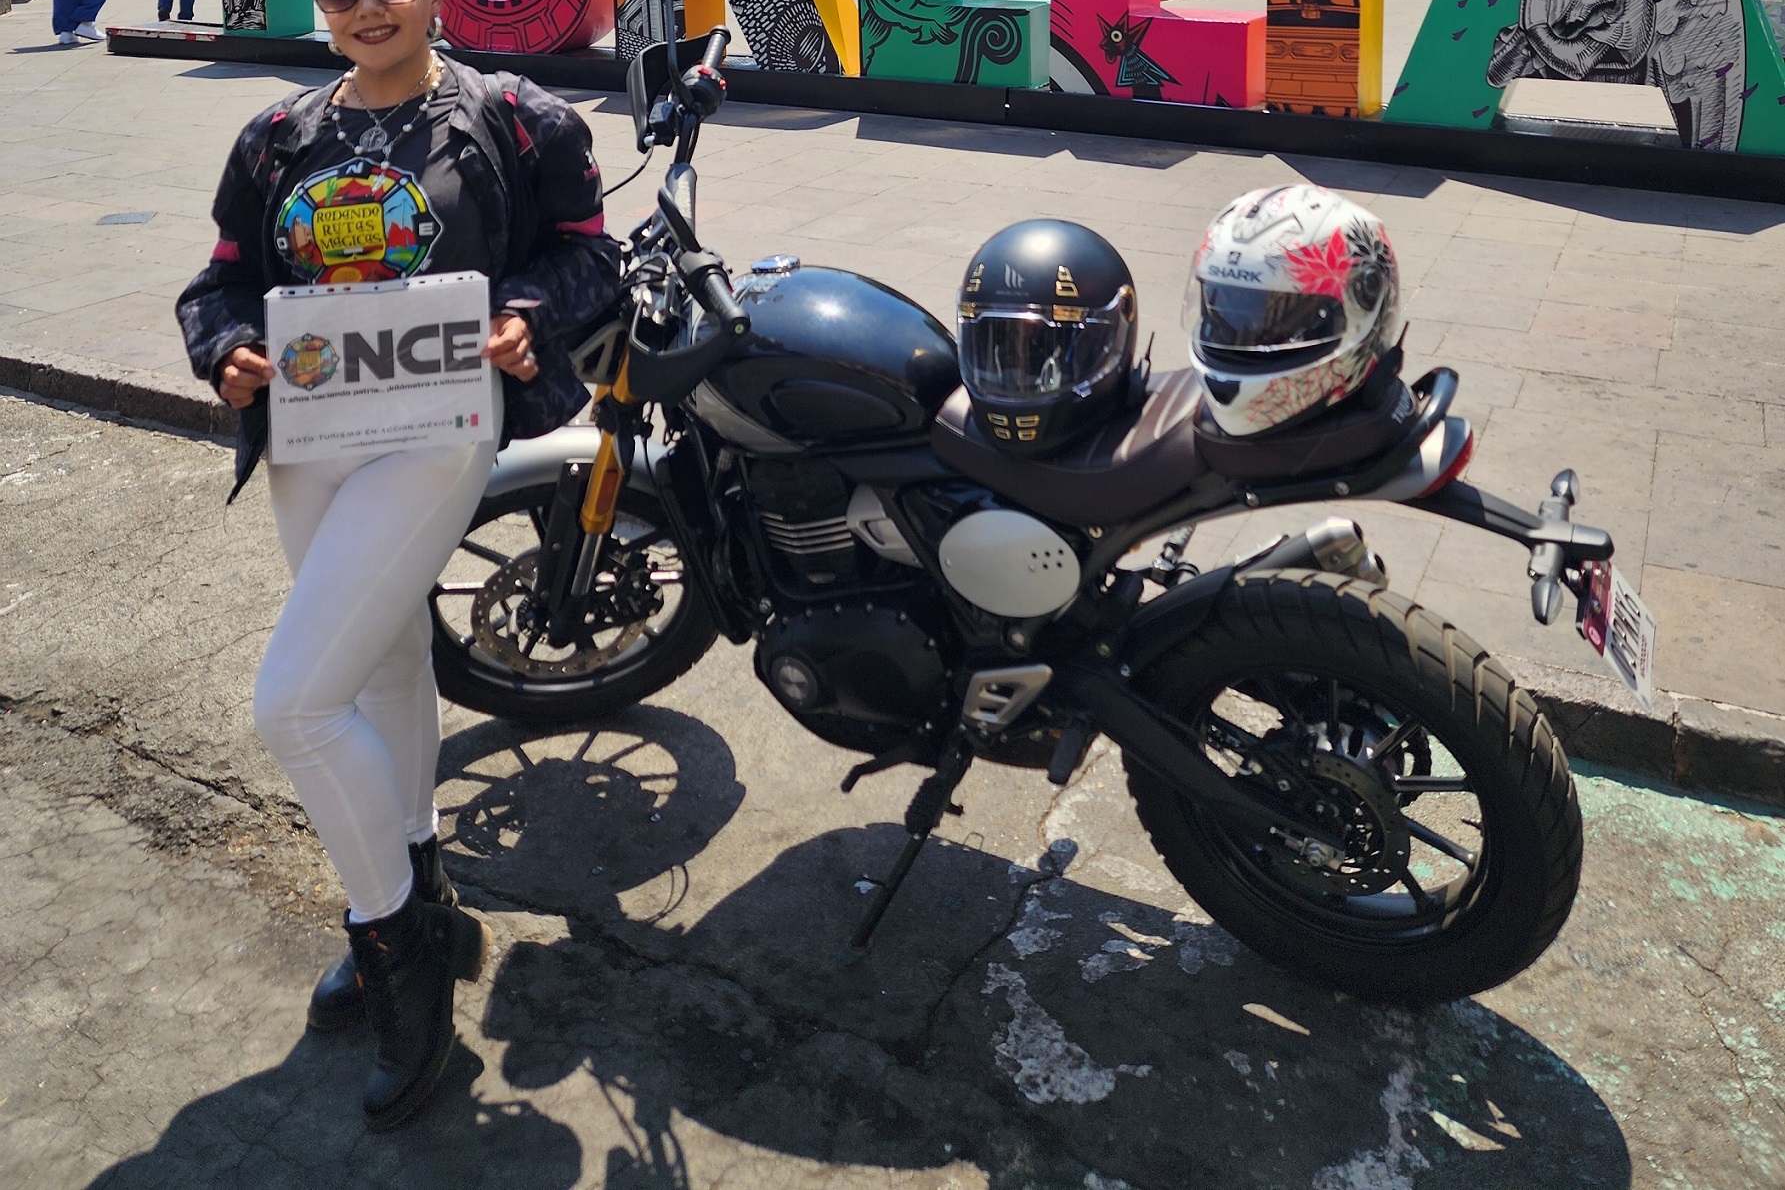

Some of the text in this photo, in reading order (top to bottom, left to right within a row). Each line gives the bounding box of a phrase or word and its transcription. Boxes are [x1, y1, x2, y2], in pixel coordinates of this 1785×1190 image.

[316, 207, 380, 224] RODANDO
[322, 219, 375, 236] RUTAS
[1208, 265, 1263, 283] SHARK
